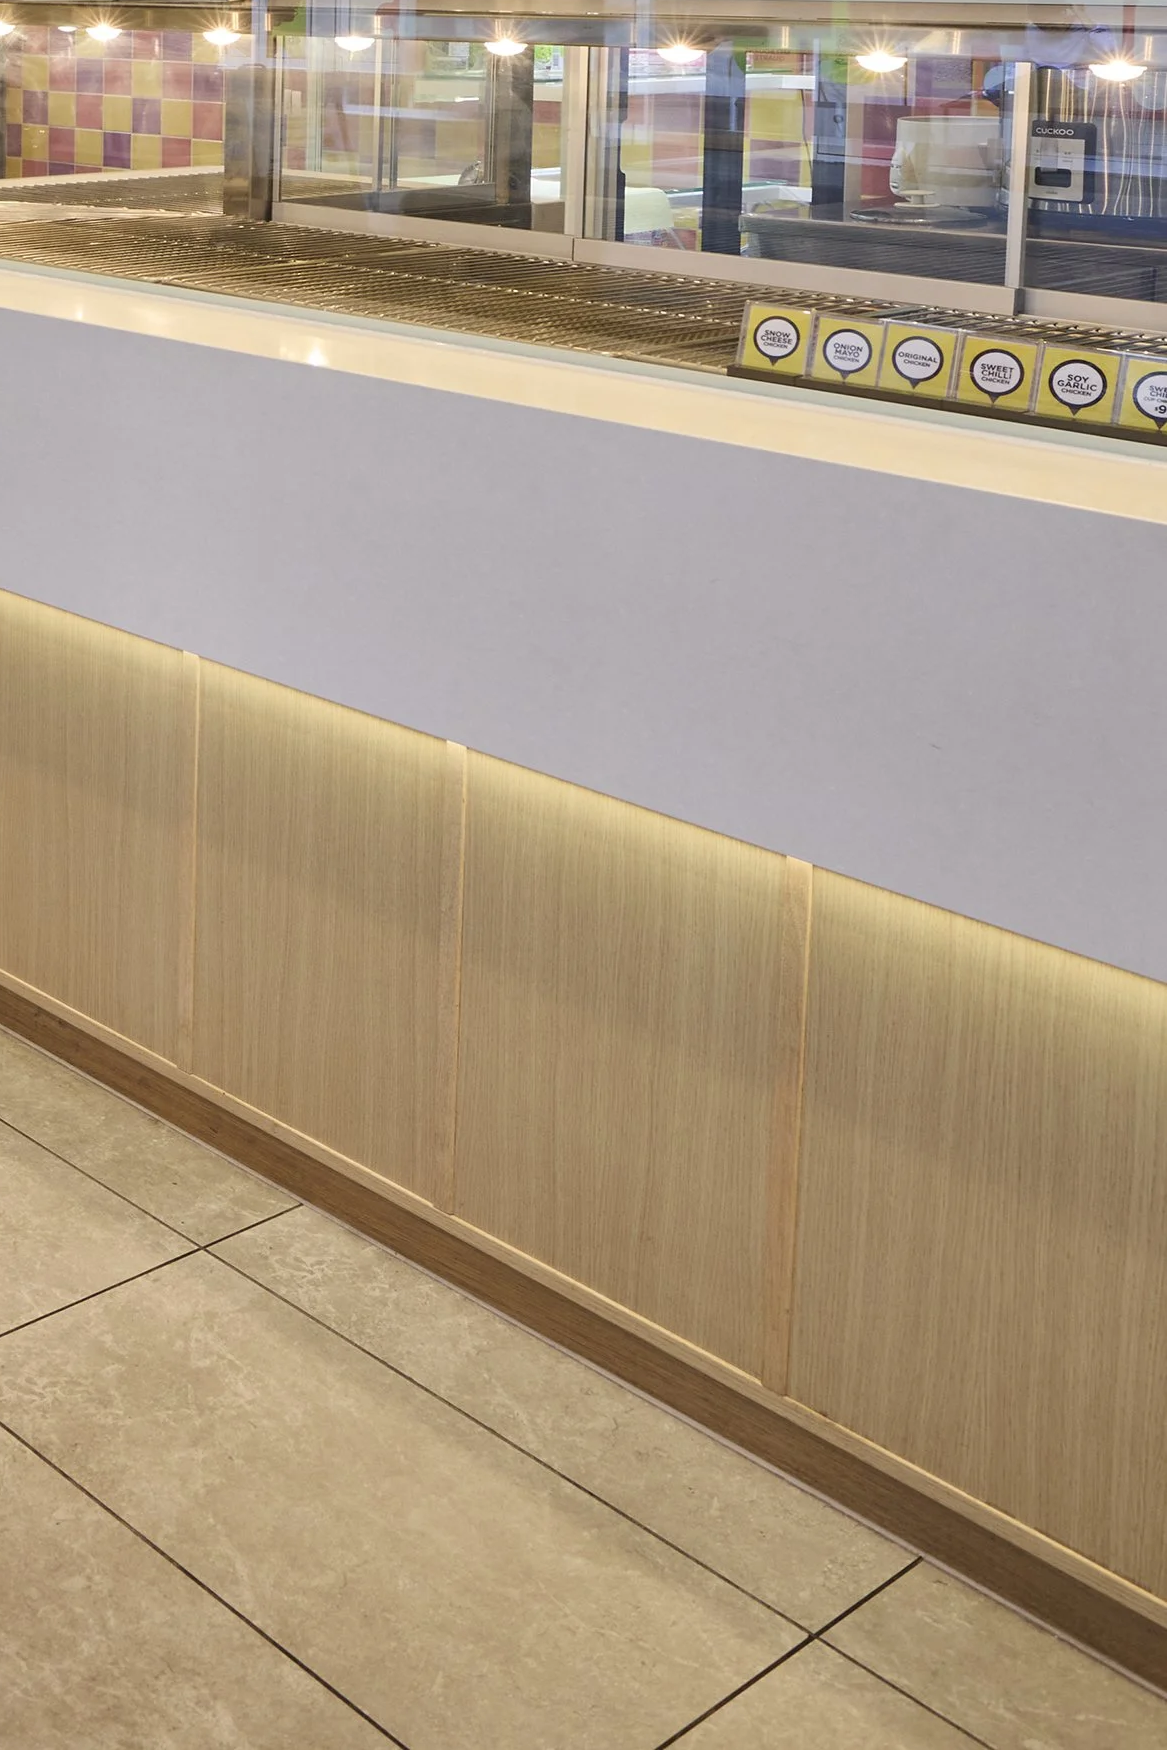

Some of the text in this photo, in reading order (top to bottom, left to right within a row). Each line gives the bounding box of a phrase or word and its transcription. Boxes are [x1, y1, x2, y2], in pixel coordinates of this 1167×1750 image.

[1035, 127, 1074, 136] CUCKOO
[764, 329, 791, 339] SNOW
[760, 335, 792, 345] CHEESE
[763, 341, 788, 349] CHICKEN
[833, 342, 863, 353] ONION
[834, 349, 861, 358] MAYO
[898, 351, 939, 364] ORIGINAL
[833, 355, 860, 363] CHICKEN
[903, 359, 931, 368] CHICKEN
[980, 363, 1014, 374] SWEET
[981, 370, 1012, 380] CHILLI
[1066, 374, 1090, 383] SOY
[981, 376, 1010, 385] CHICKEN
[1057, 379, 1098, 392] GARLIC
[1061, 387, 1092, 397] CHICKEN
